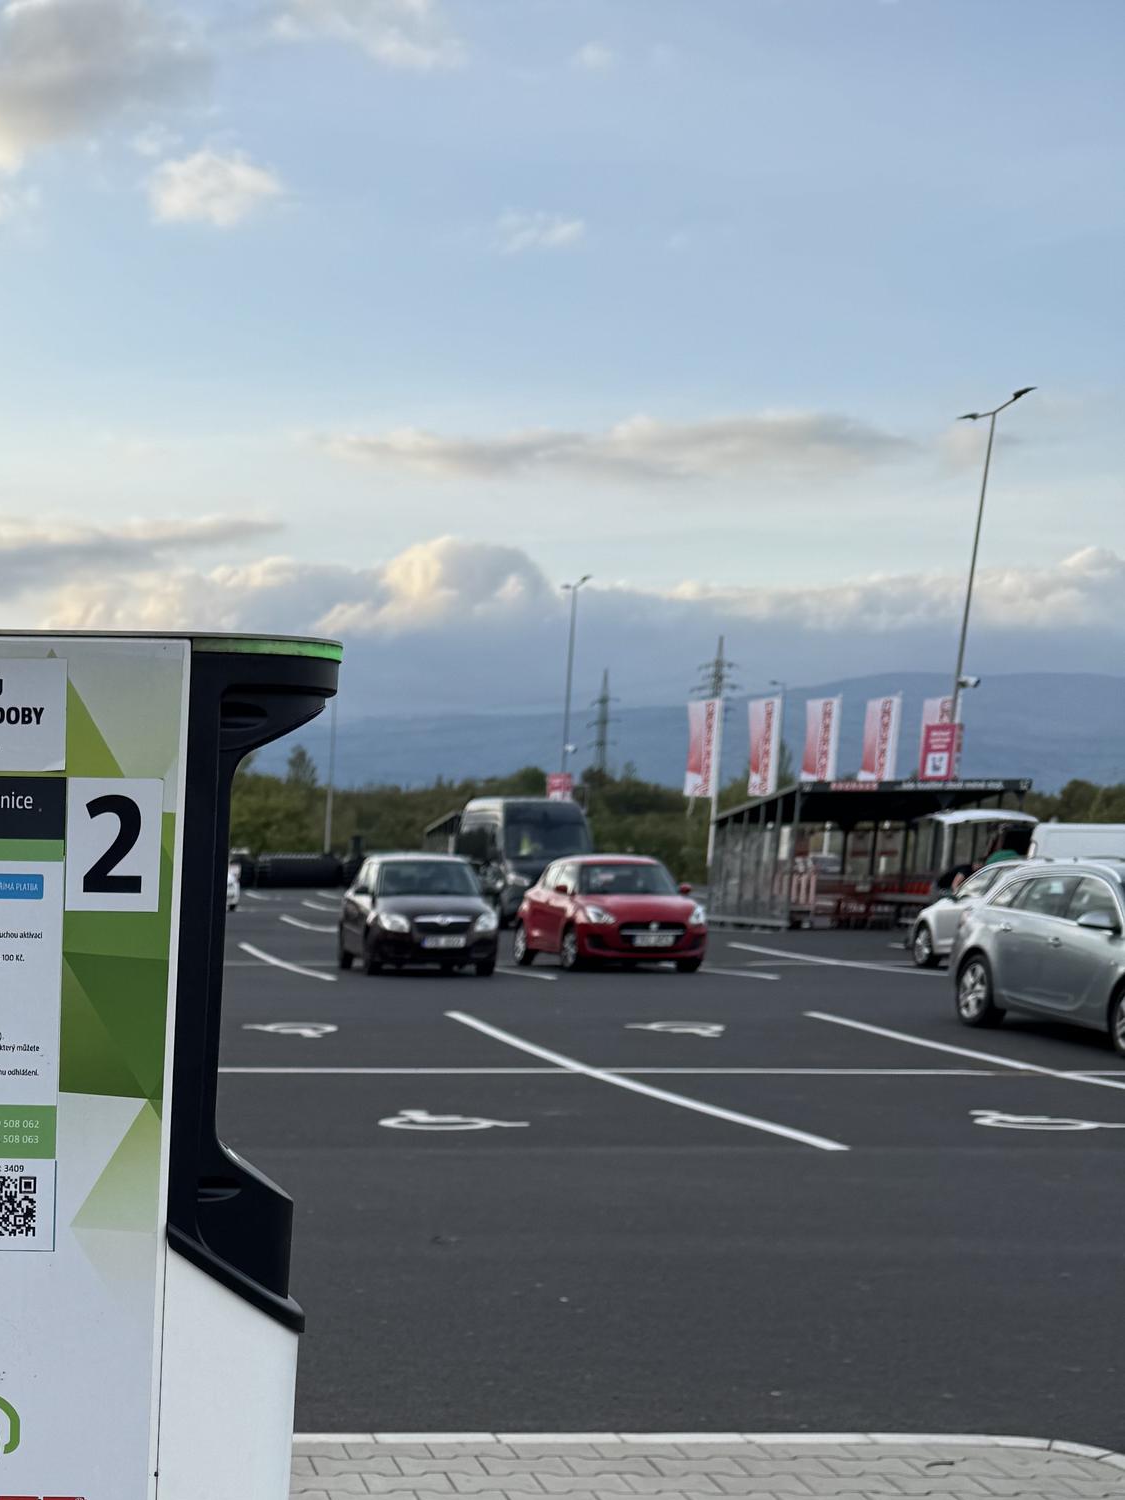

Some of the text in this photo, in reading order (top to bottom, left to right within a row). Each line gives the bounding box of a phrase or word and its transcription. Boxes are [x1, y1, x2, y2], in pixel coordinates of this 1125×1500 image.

[83, 794, 141, 893] 2
[3, 1119, 20, 1128] 508
[22, 1119, 39, 1129] 062
[3, 1134, 20, 1144] 508
[22, 1135, 39, 1144] 063
[4, 1164, 25, 1174] 3409
